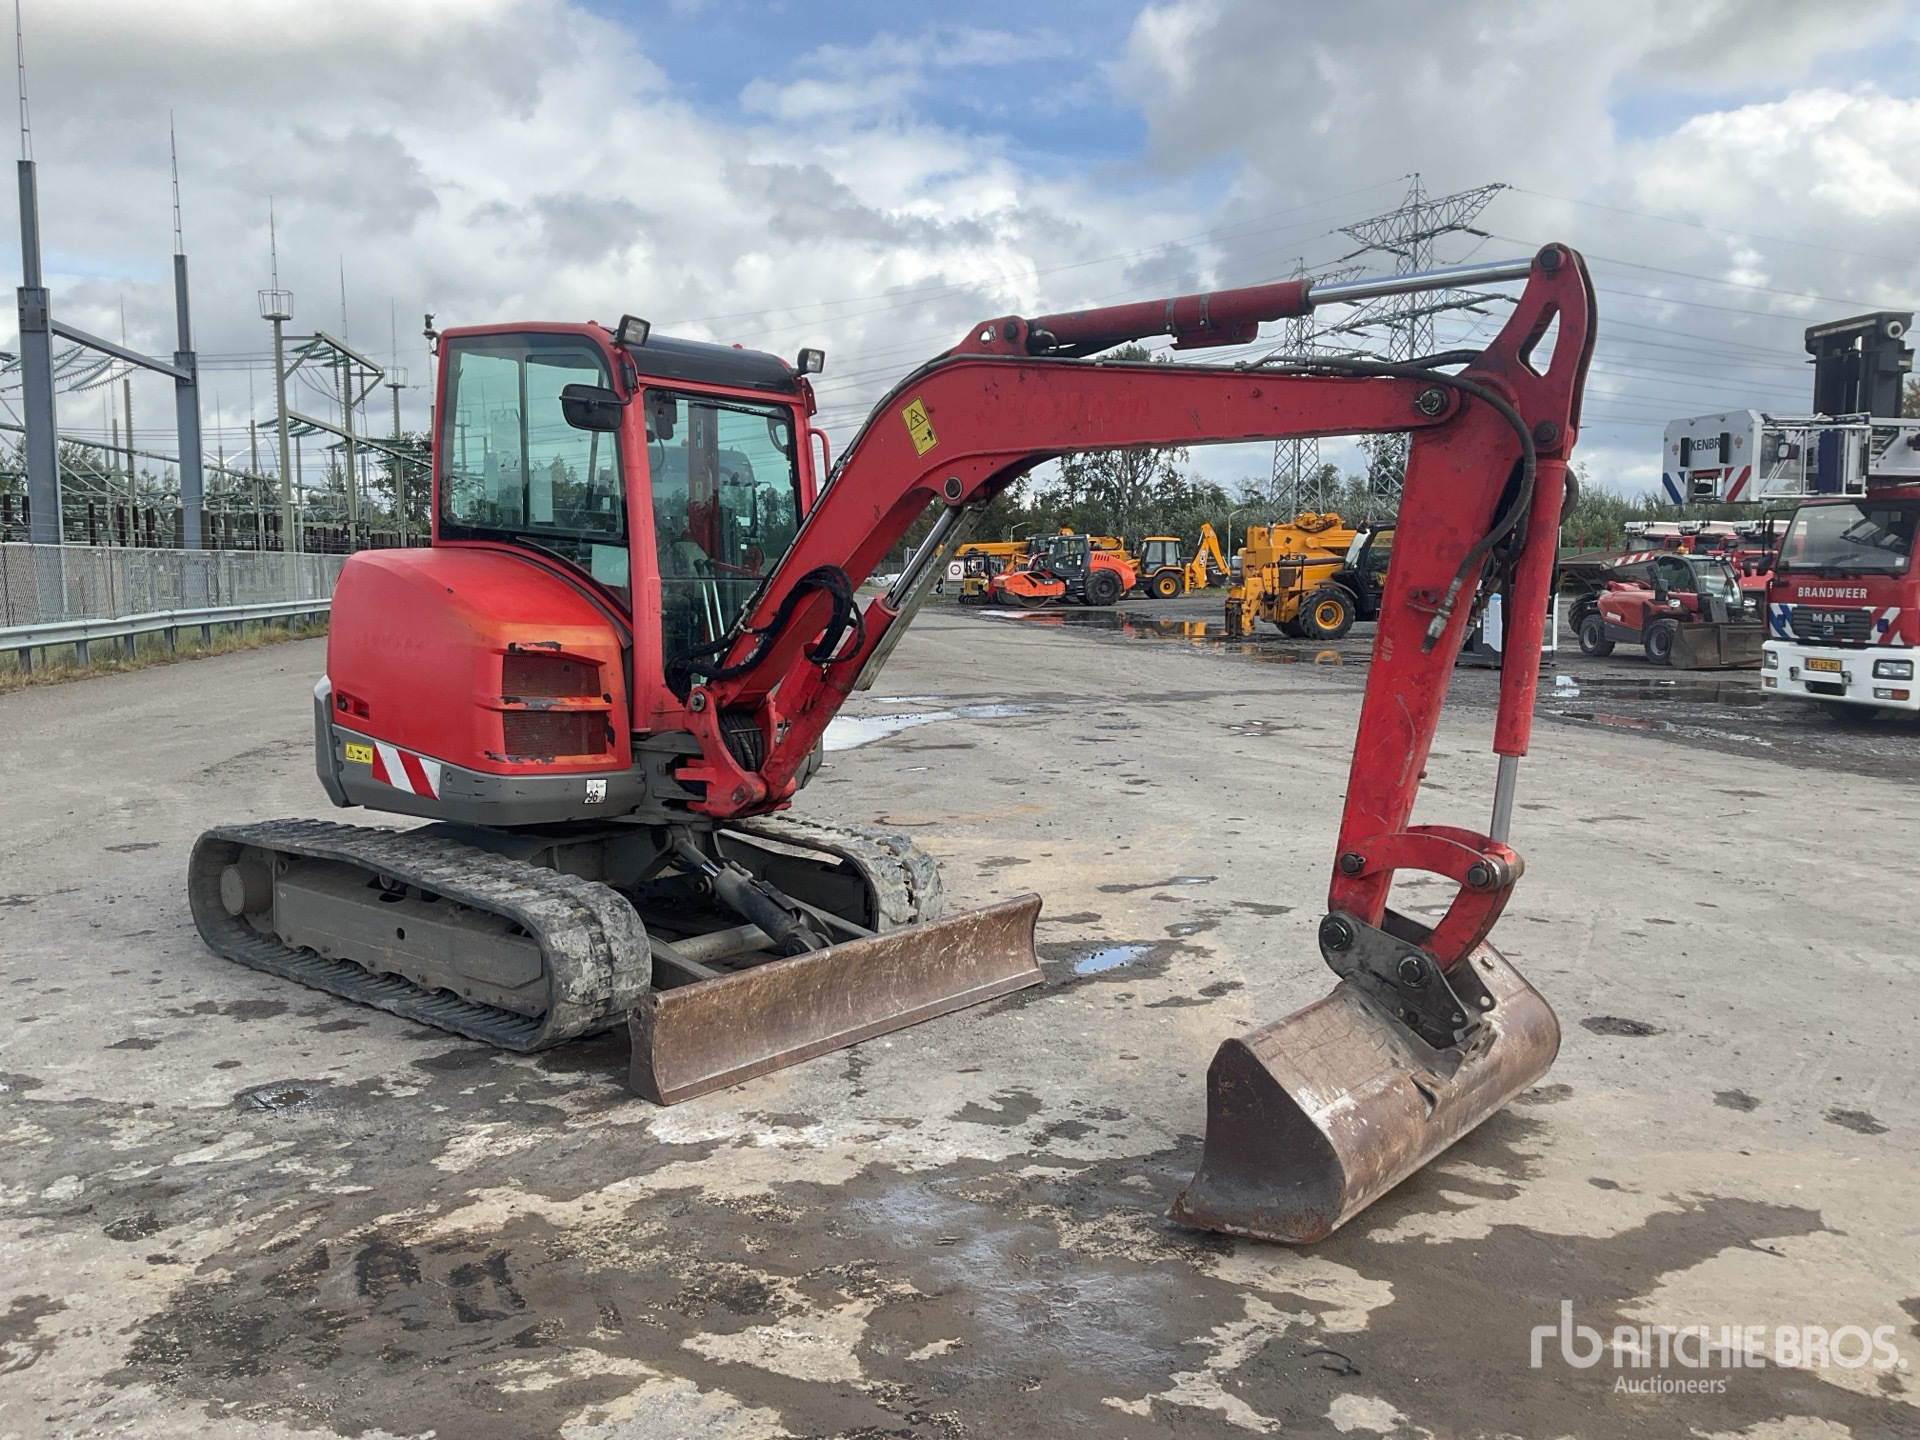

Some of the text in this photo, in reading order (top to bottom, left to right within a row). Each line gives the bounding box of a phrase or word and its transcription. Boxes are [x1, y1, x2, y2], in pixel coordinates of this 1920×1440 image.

[1690, 437, 1721, 452] KENBR
[1797, 586, 1868, 599] BRANDWEER
[1812, 613, 1846, 624] MAN
